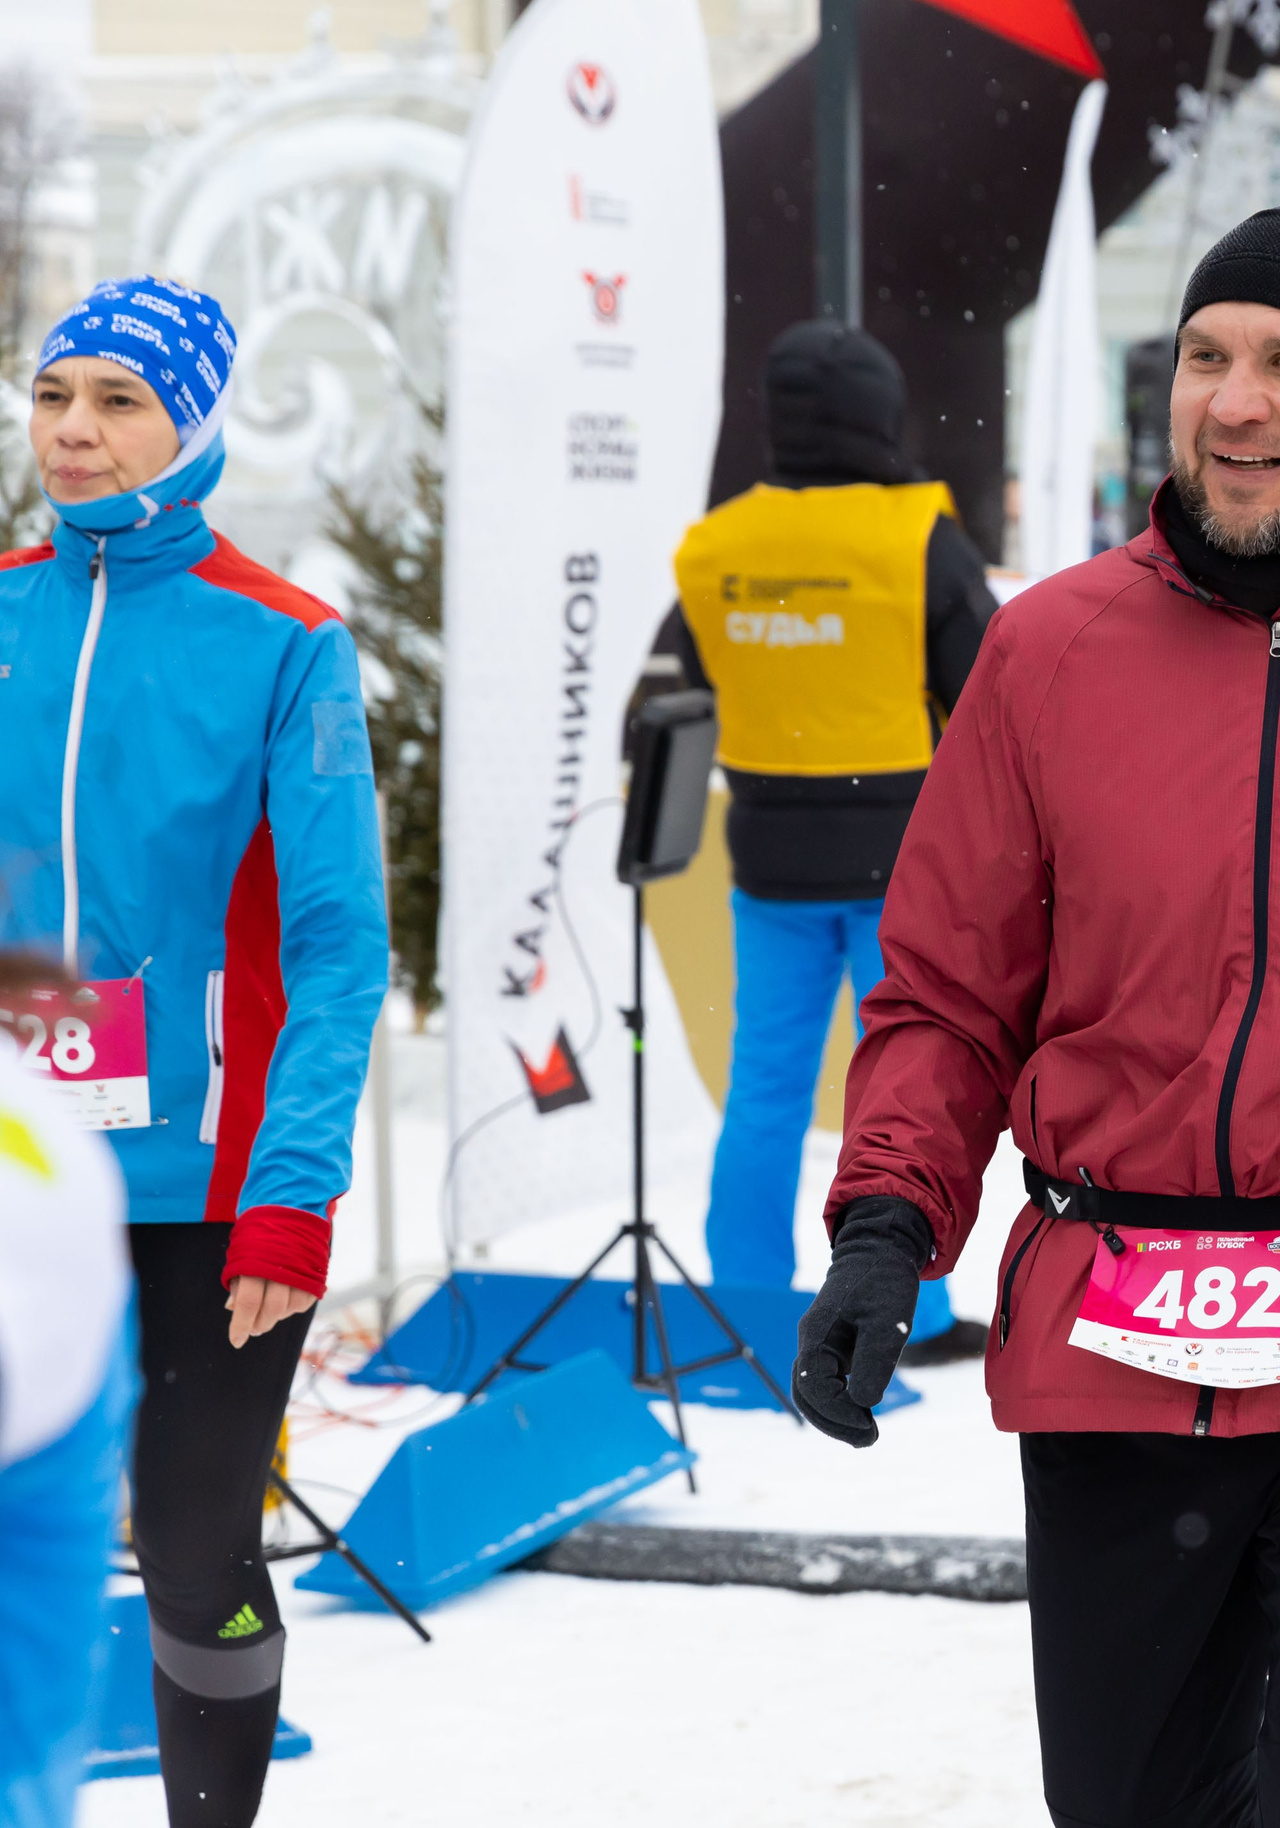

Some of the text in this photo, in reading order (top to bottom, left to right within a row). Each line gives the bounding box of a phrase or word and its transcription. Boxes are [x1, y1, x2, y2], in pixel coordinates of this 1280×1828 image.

[110, 321, 171, 357] СПОРТА
[112, 313, 163, 341] ТОЧКА
[98, 350, 144, 375] ТОЧКА
[725, 610, 845, 649] СУДЬЯ
[1149, 1240, 1181, 1252] РСХБ
